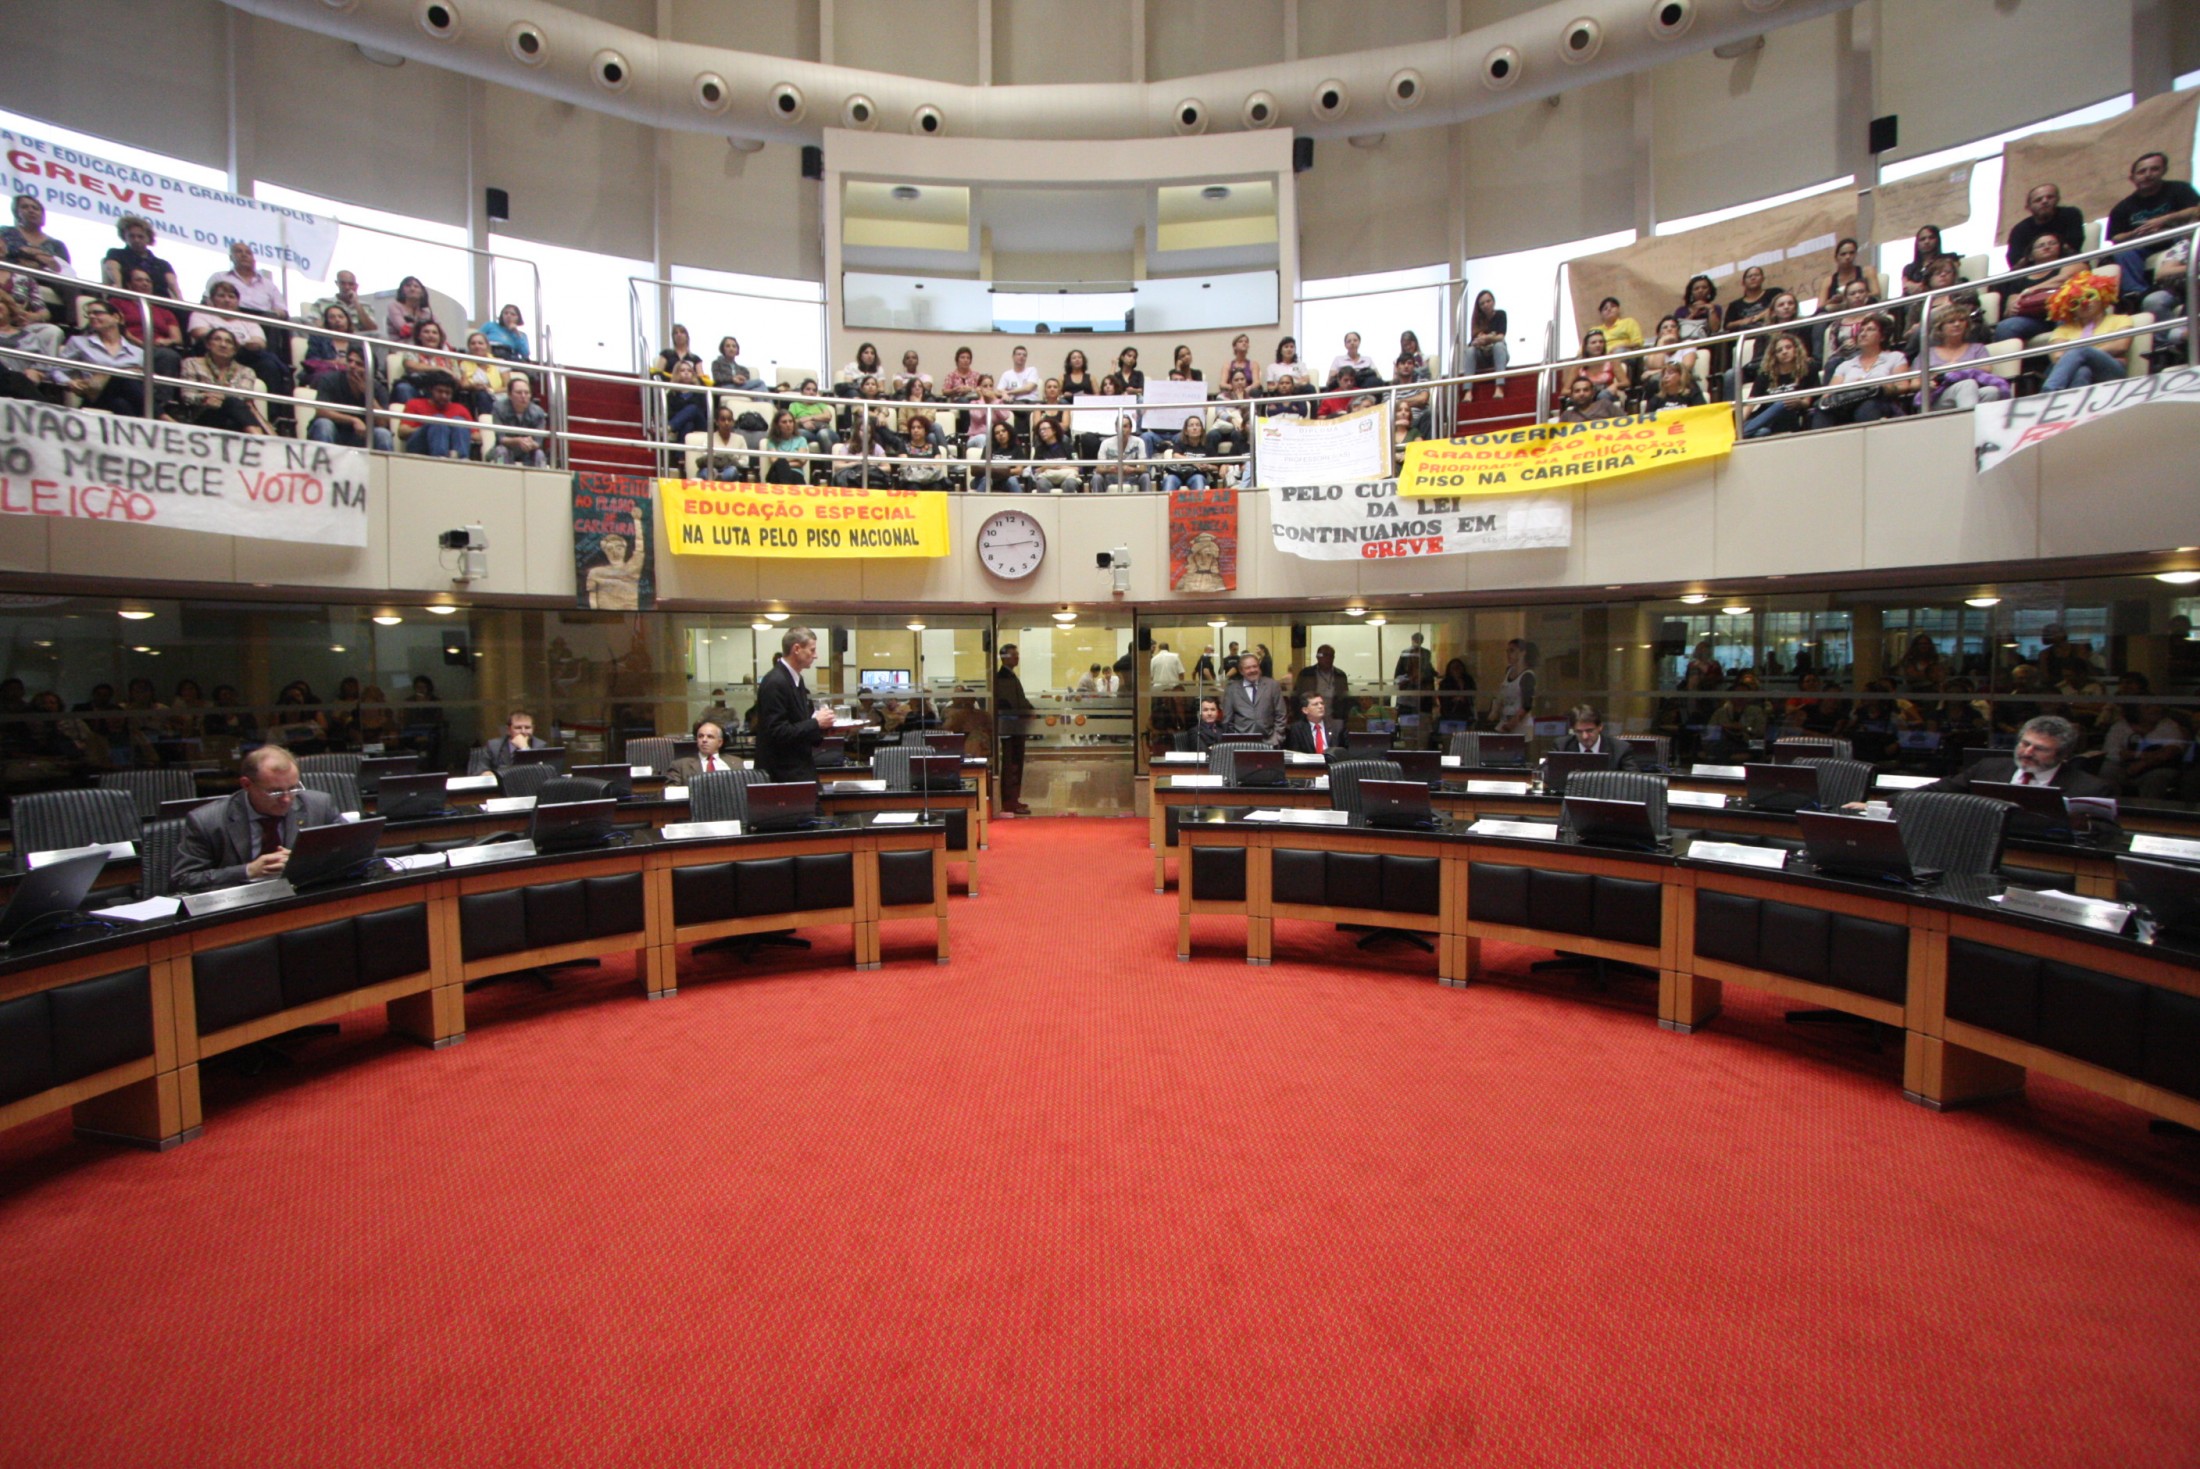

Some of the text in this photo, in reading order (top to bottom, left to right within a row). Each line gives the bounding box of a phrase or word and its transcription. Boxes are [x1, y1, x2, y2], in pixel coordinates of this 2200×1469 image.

[7, 150, 165, 214] GREVE
[20, 136, 46, 153] DE
[53, 145, 154, 188] EDUCAÇÃO
[160, 178, 184, 194] DA
[189, 185, 257, 210] GRANDE
[13, 177, 39, 197] DO
[46, 187, 91, 210] PISO
[98, 201, 189, 239] NAONAL
[194, 229, 218, 245] DO
[223, 235, 311, 271] MGISTÉRIO
[1423, 421, 1685, 460] GRADUAÇÃO NÃO É
[1450, 411, 1657, 446] GOVERNADOR
[98, 416, 265, 468] INVESTE
[285, 443, 333, 474] NA
[63, 448, 224, 497] MERECE
[238, 470, 324, 505] VOTO
[331, 480, 366, 513] NA
[1415, 474, 1465, 486] PISO
[1478, 472, 1507, 485] NA
[1520, 454, 1635, 482] CARREIRA
[681, 479, 870, 498] PROFESSORES
[1282, 485, 1343, 501] PELO
[684, 500, 916, 521] EDUCAÇÃO ESPECIAL
[1367, 497, 1461, 518] DA LEI
[683, 524, 920, 548] NA LUTA PELO PISO NACIONAL
[1272, 515, 1496, 543] CONTINUAMOS EM
[1362, 536, 1444, 559] GREVE
